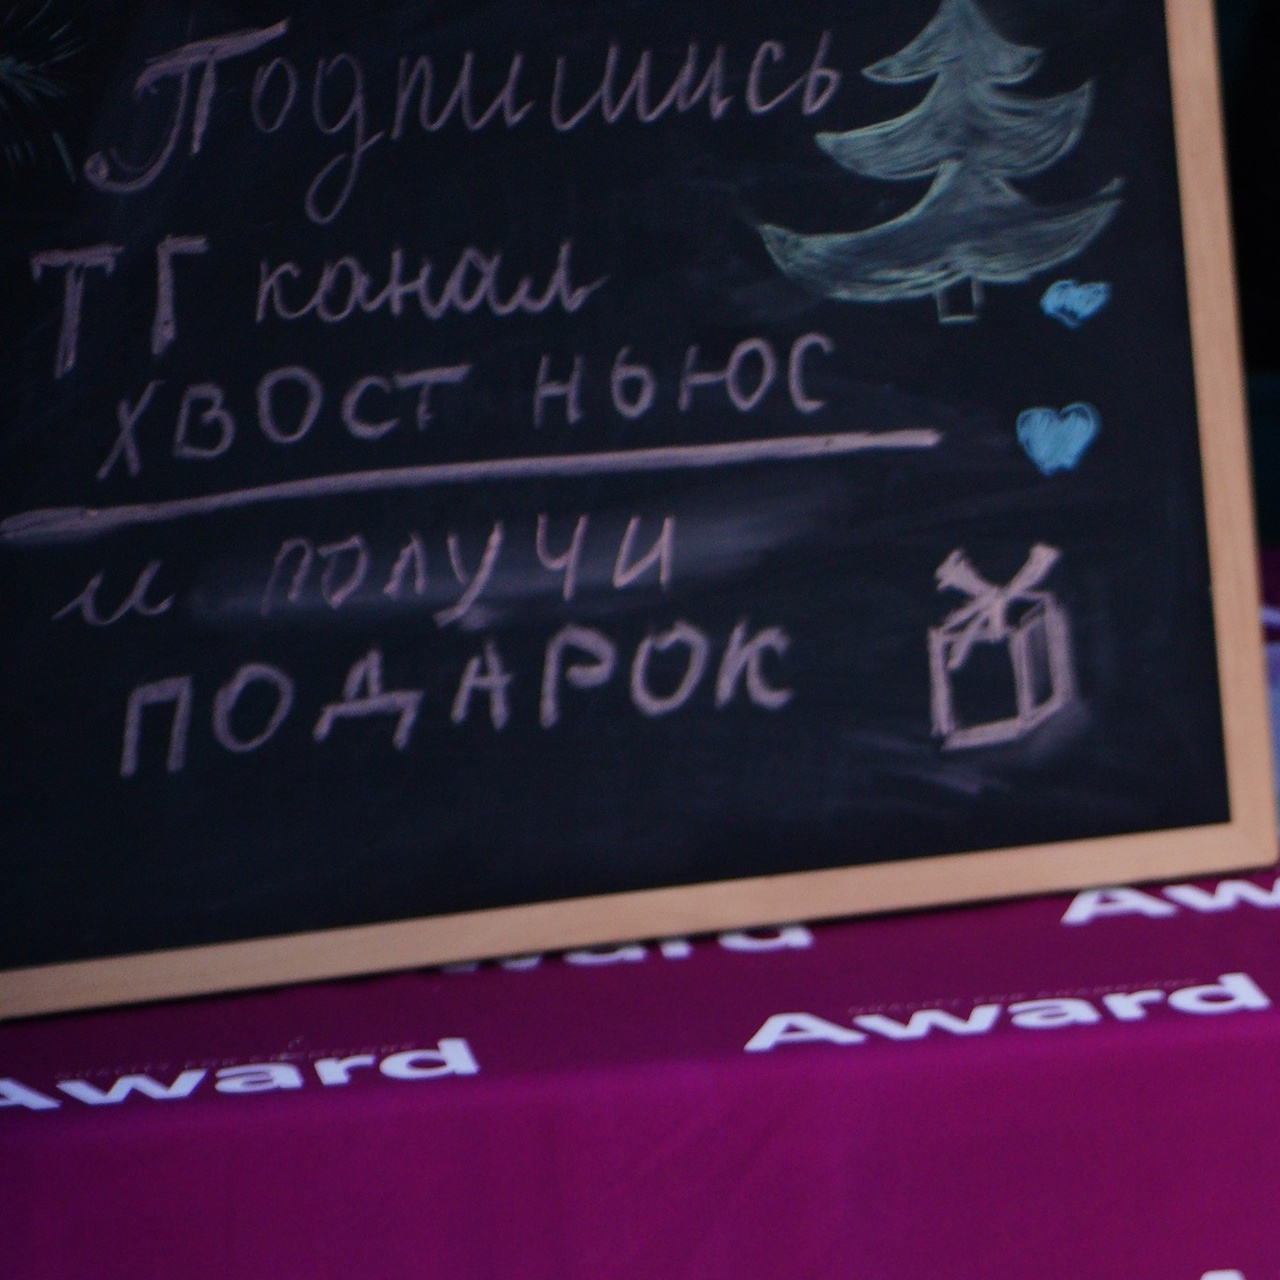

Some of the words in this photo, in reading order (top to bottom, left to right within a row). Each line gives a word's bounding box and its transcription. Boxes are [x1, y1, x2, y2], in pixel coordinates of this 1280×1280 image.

[83, 18, 842, 225] Подпишись
[253, 240, 608, 323] канал
[122, 617, 794, 777] ПОДАРОК
[744, 972, 1270, 1052] Award
